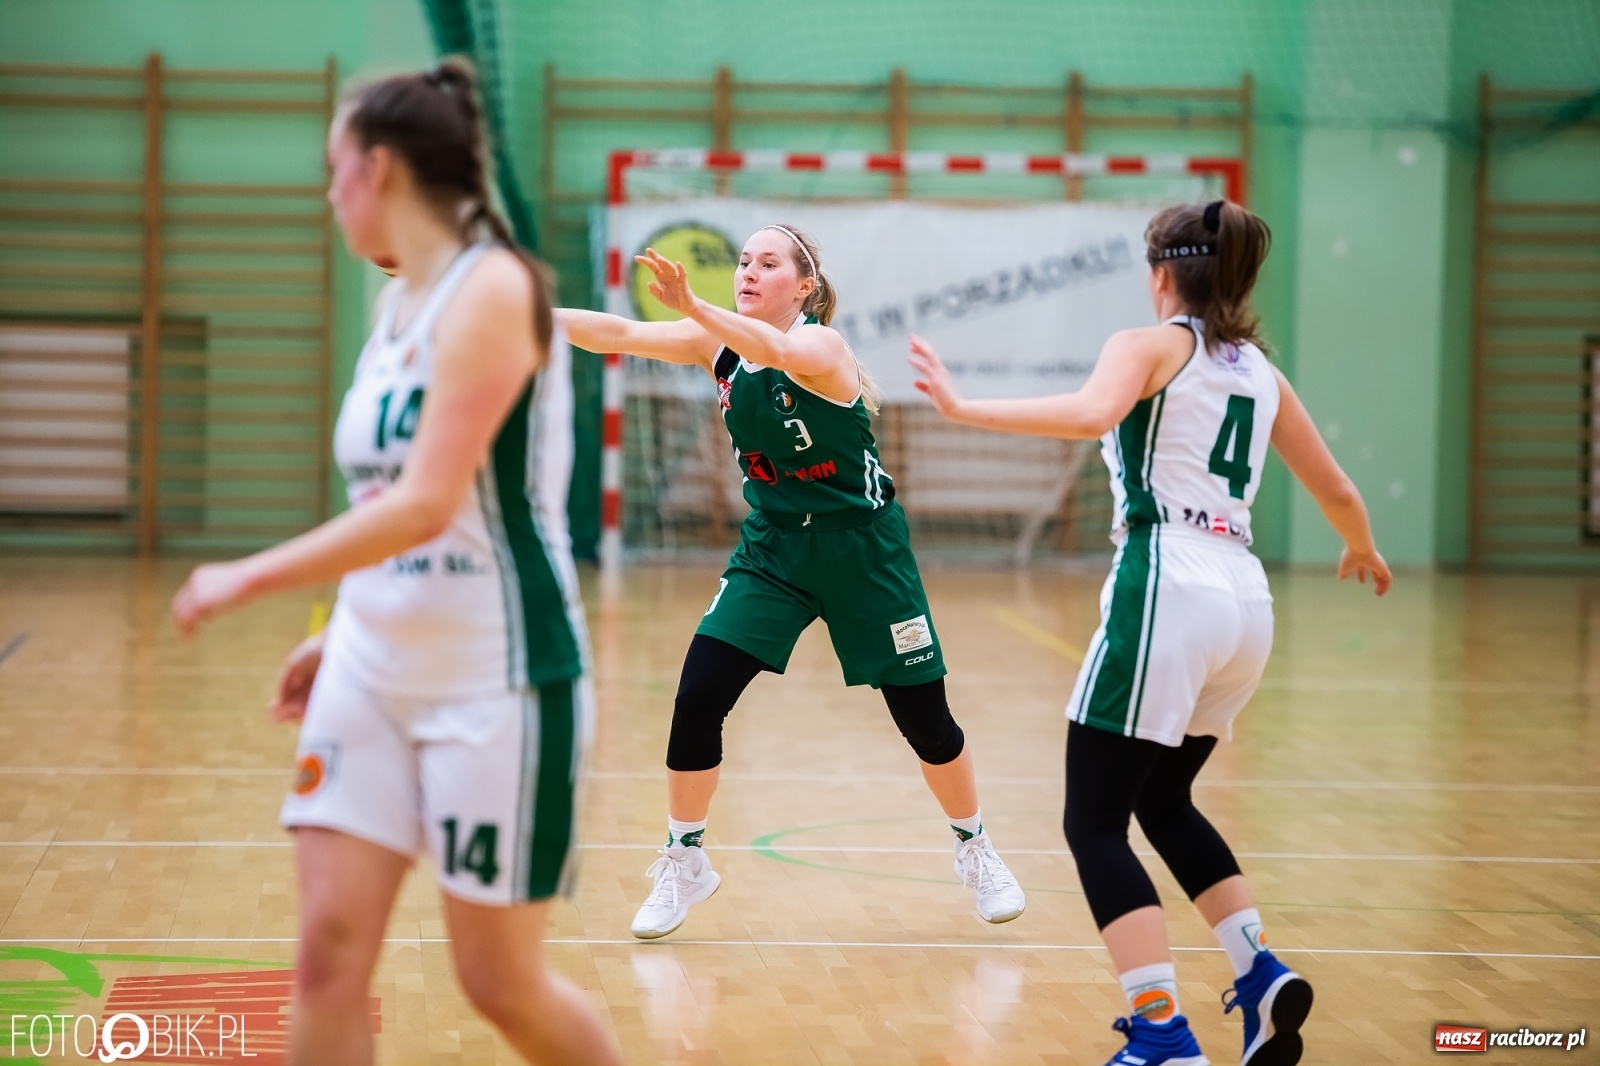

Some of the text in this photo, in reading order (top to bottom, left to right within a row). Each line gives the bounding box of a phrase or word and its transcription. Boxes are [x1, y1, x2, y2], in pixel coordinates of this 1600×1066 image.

[783, 418, 813, 452] 3
[1208, 394, 1255, 500] 4
[904, 651, 934, 666] COLO
[440, 816, 501, 887] 14
